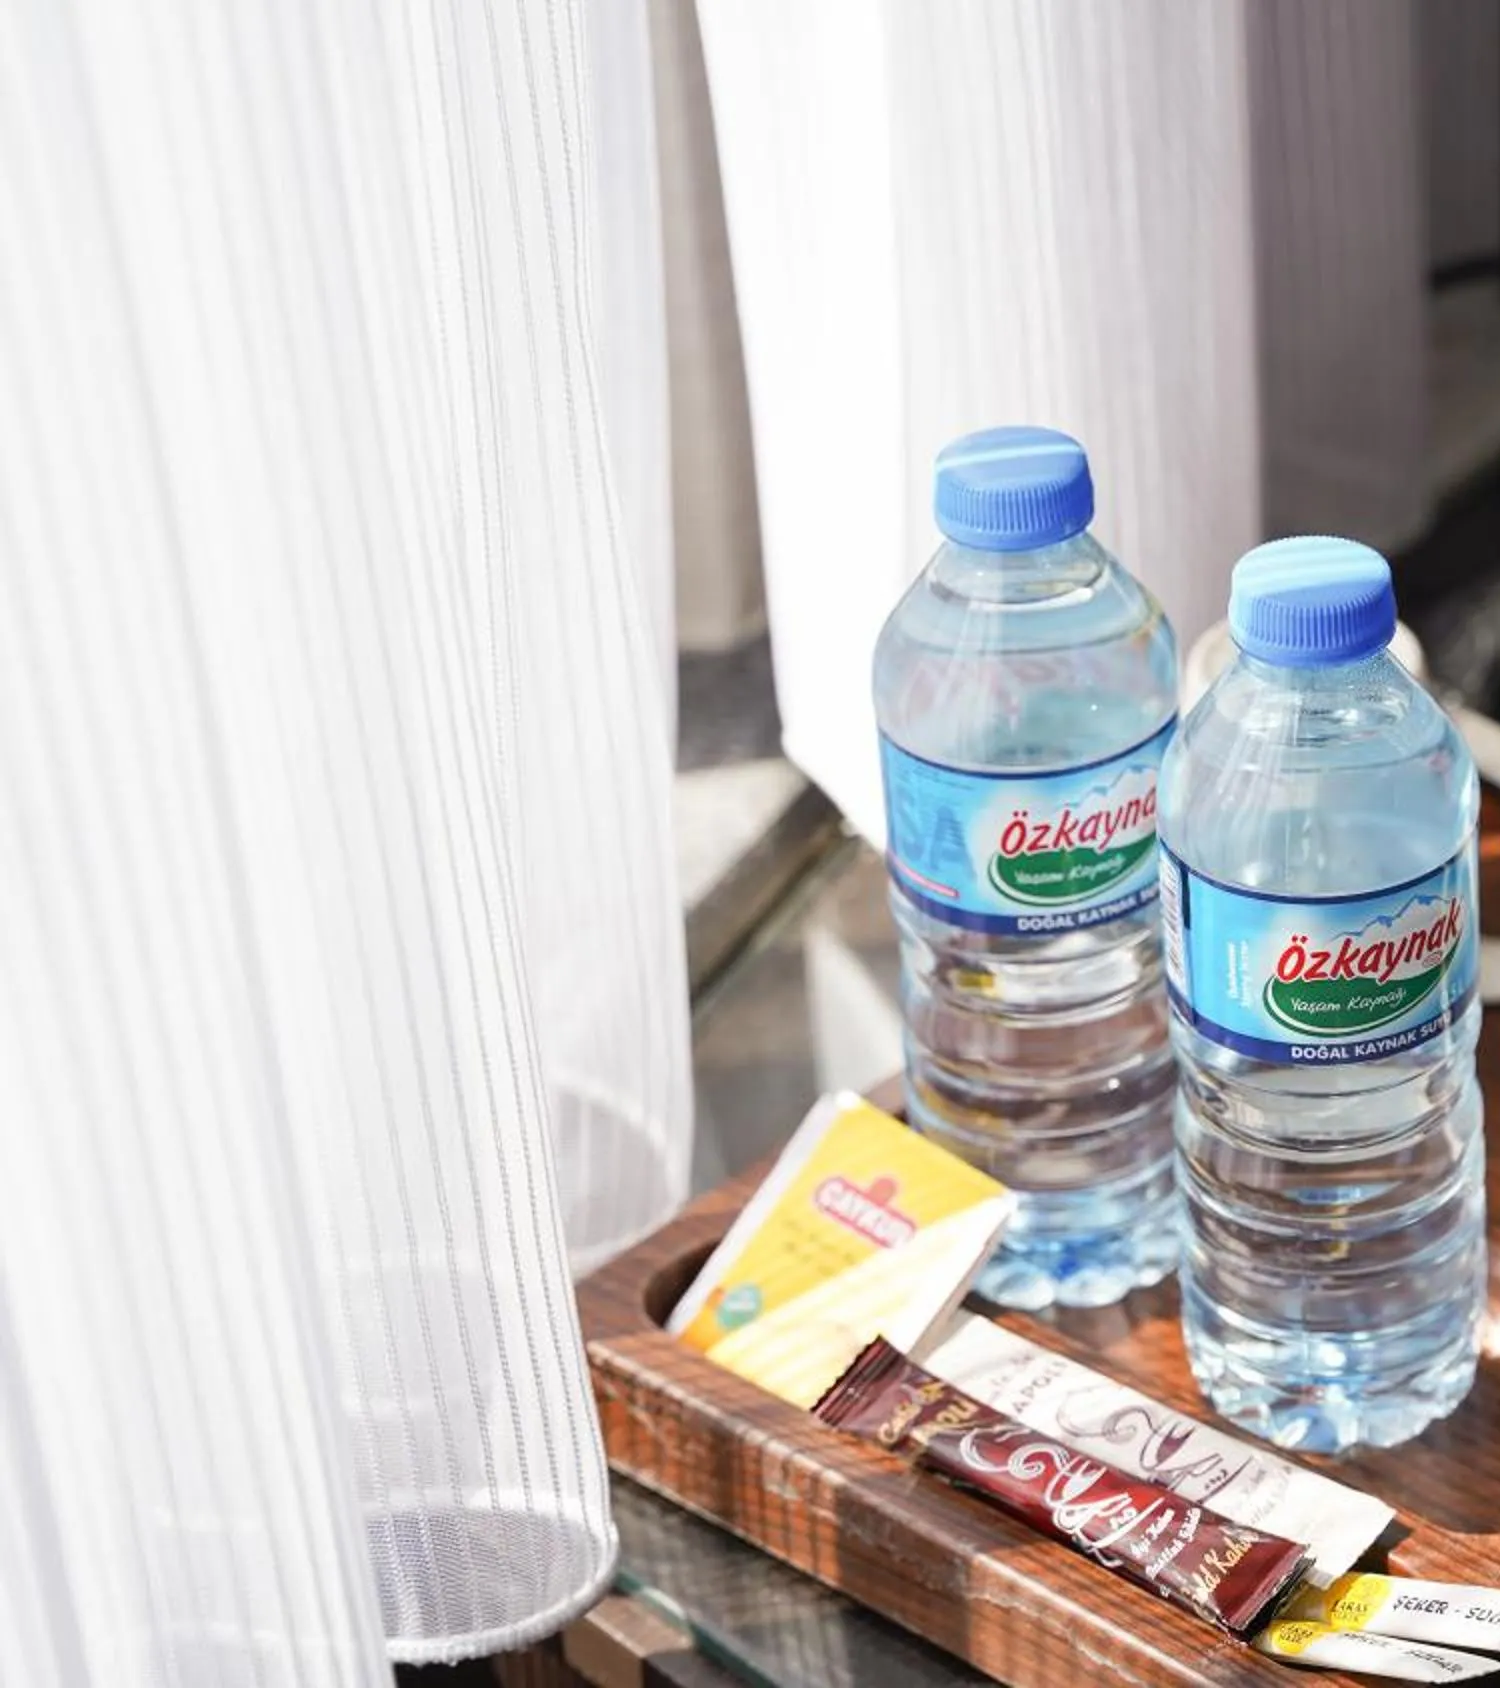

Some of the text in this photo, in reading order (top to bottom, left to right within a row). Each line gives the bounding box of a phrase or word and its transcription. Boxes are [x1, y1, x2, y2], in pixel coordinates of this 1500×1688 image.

[1000, 786, 1157, 855] Özkayna
[1017, 914, 1075, 931] DOĞAL
[1276, 896, 1462, 983] Özkaynak
[1290, 987, 1407, 1013] Yaşam Kaynağı
[1291, 1044, 1349, 1060] DOĞAL
[1354, 1030, 1417, 1057] KAYNAK
